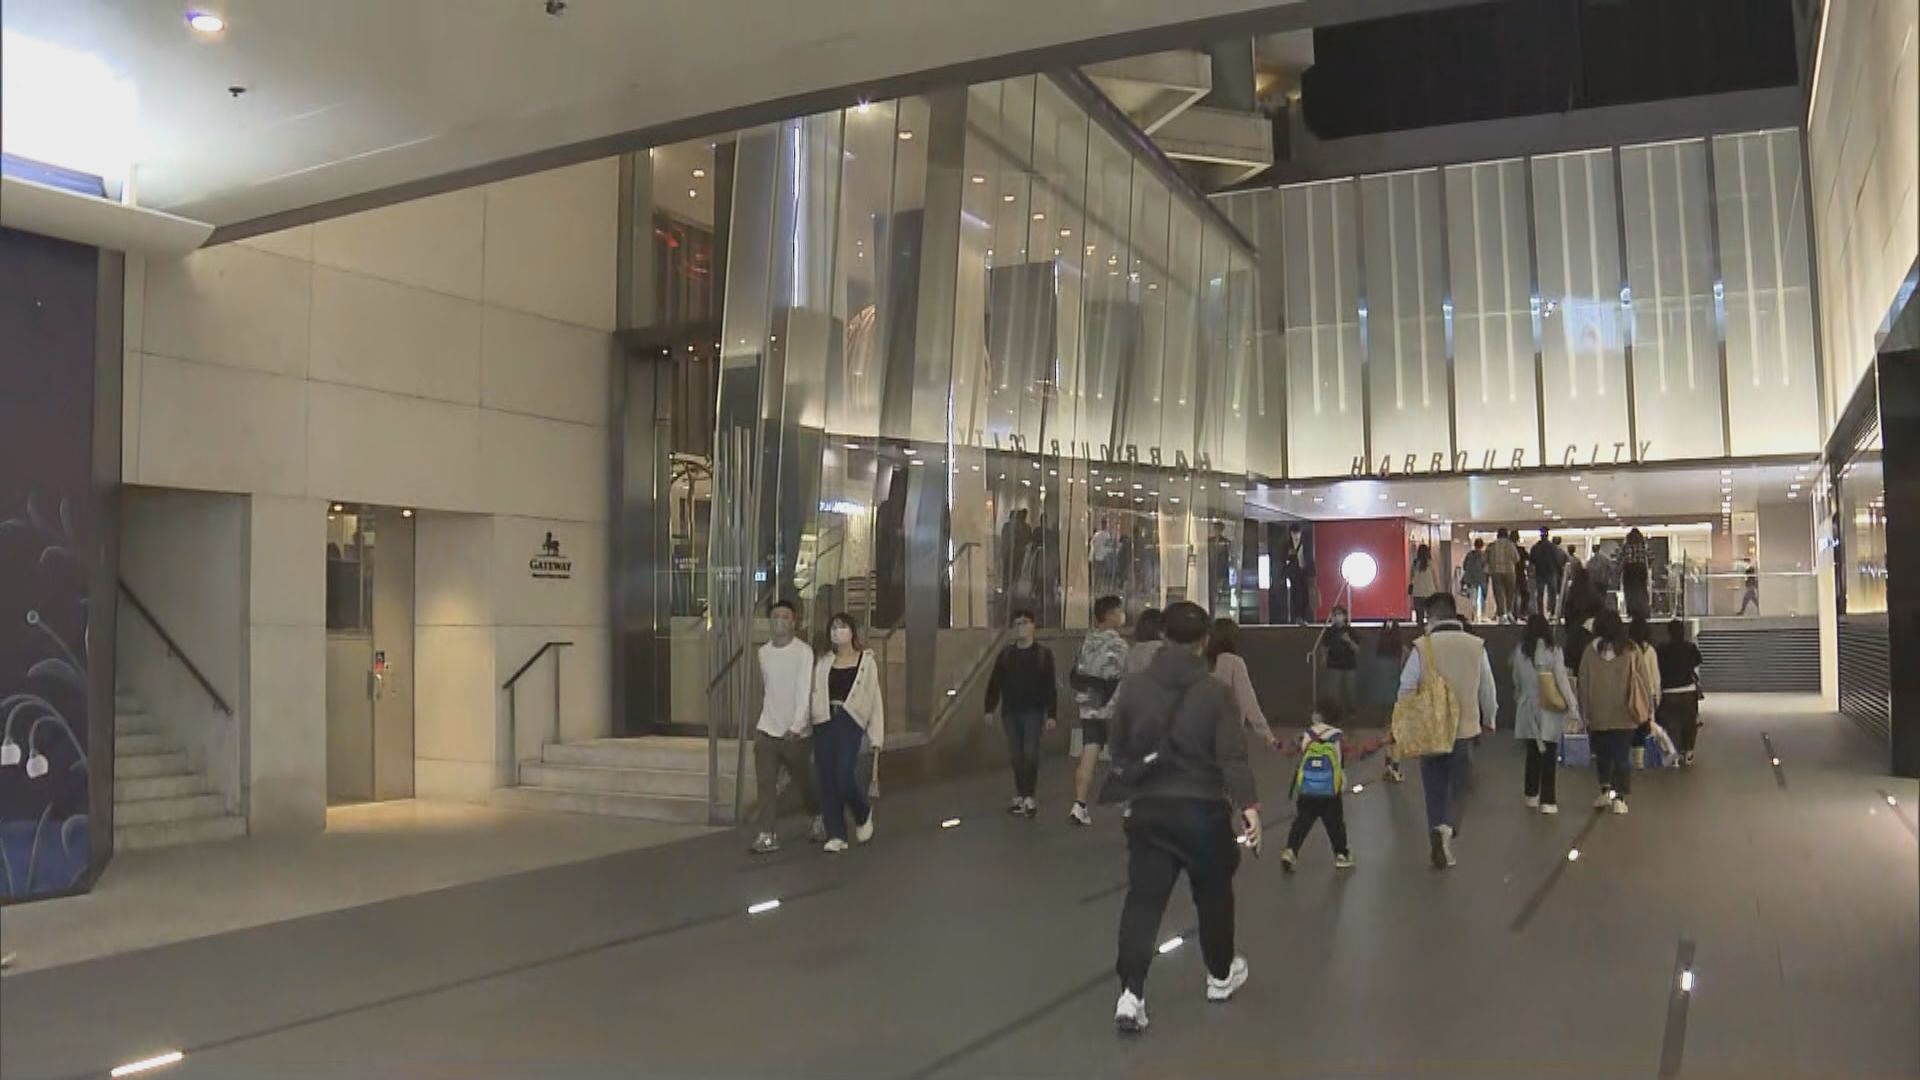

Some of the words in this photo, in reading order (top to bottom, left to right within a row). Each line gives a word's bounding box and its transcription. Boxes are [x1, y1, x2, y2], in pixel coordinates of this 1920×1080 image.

[1350, 448, 1525, 477] HARBOUR
[1564, 440, 1651, 468] CITY
[529, 558, 572, 572] GATEWAY
